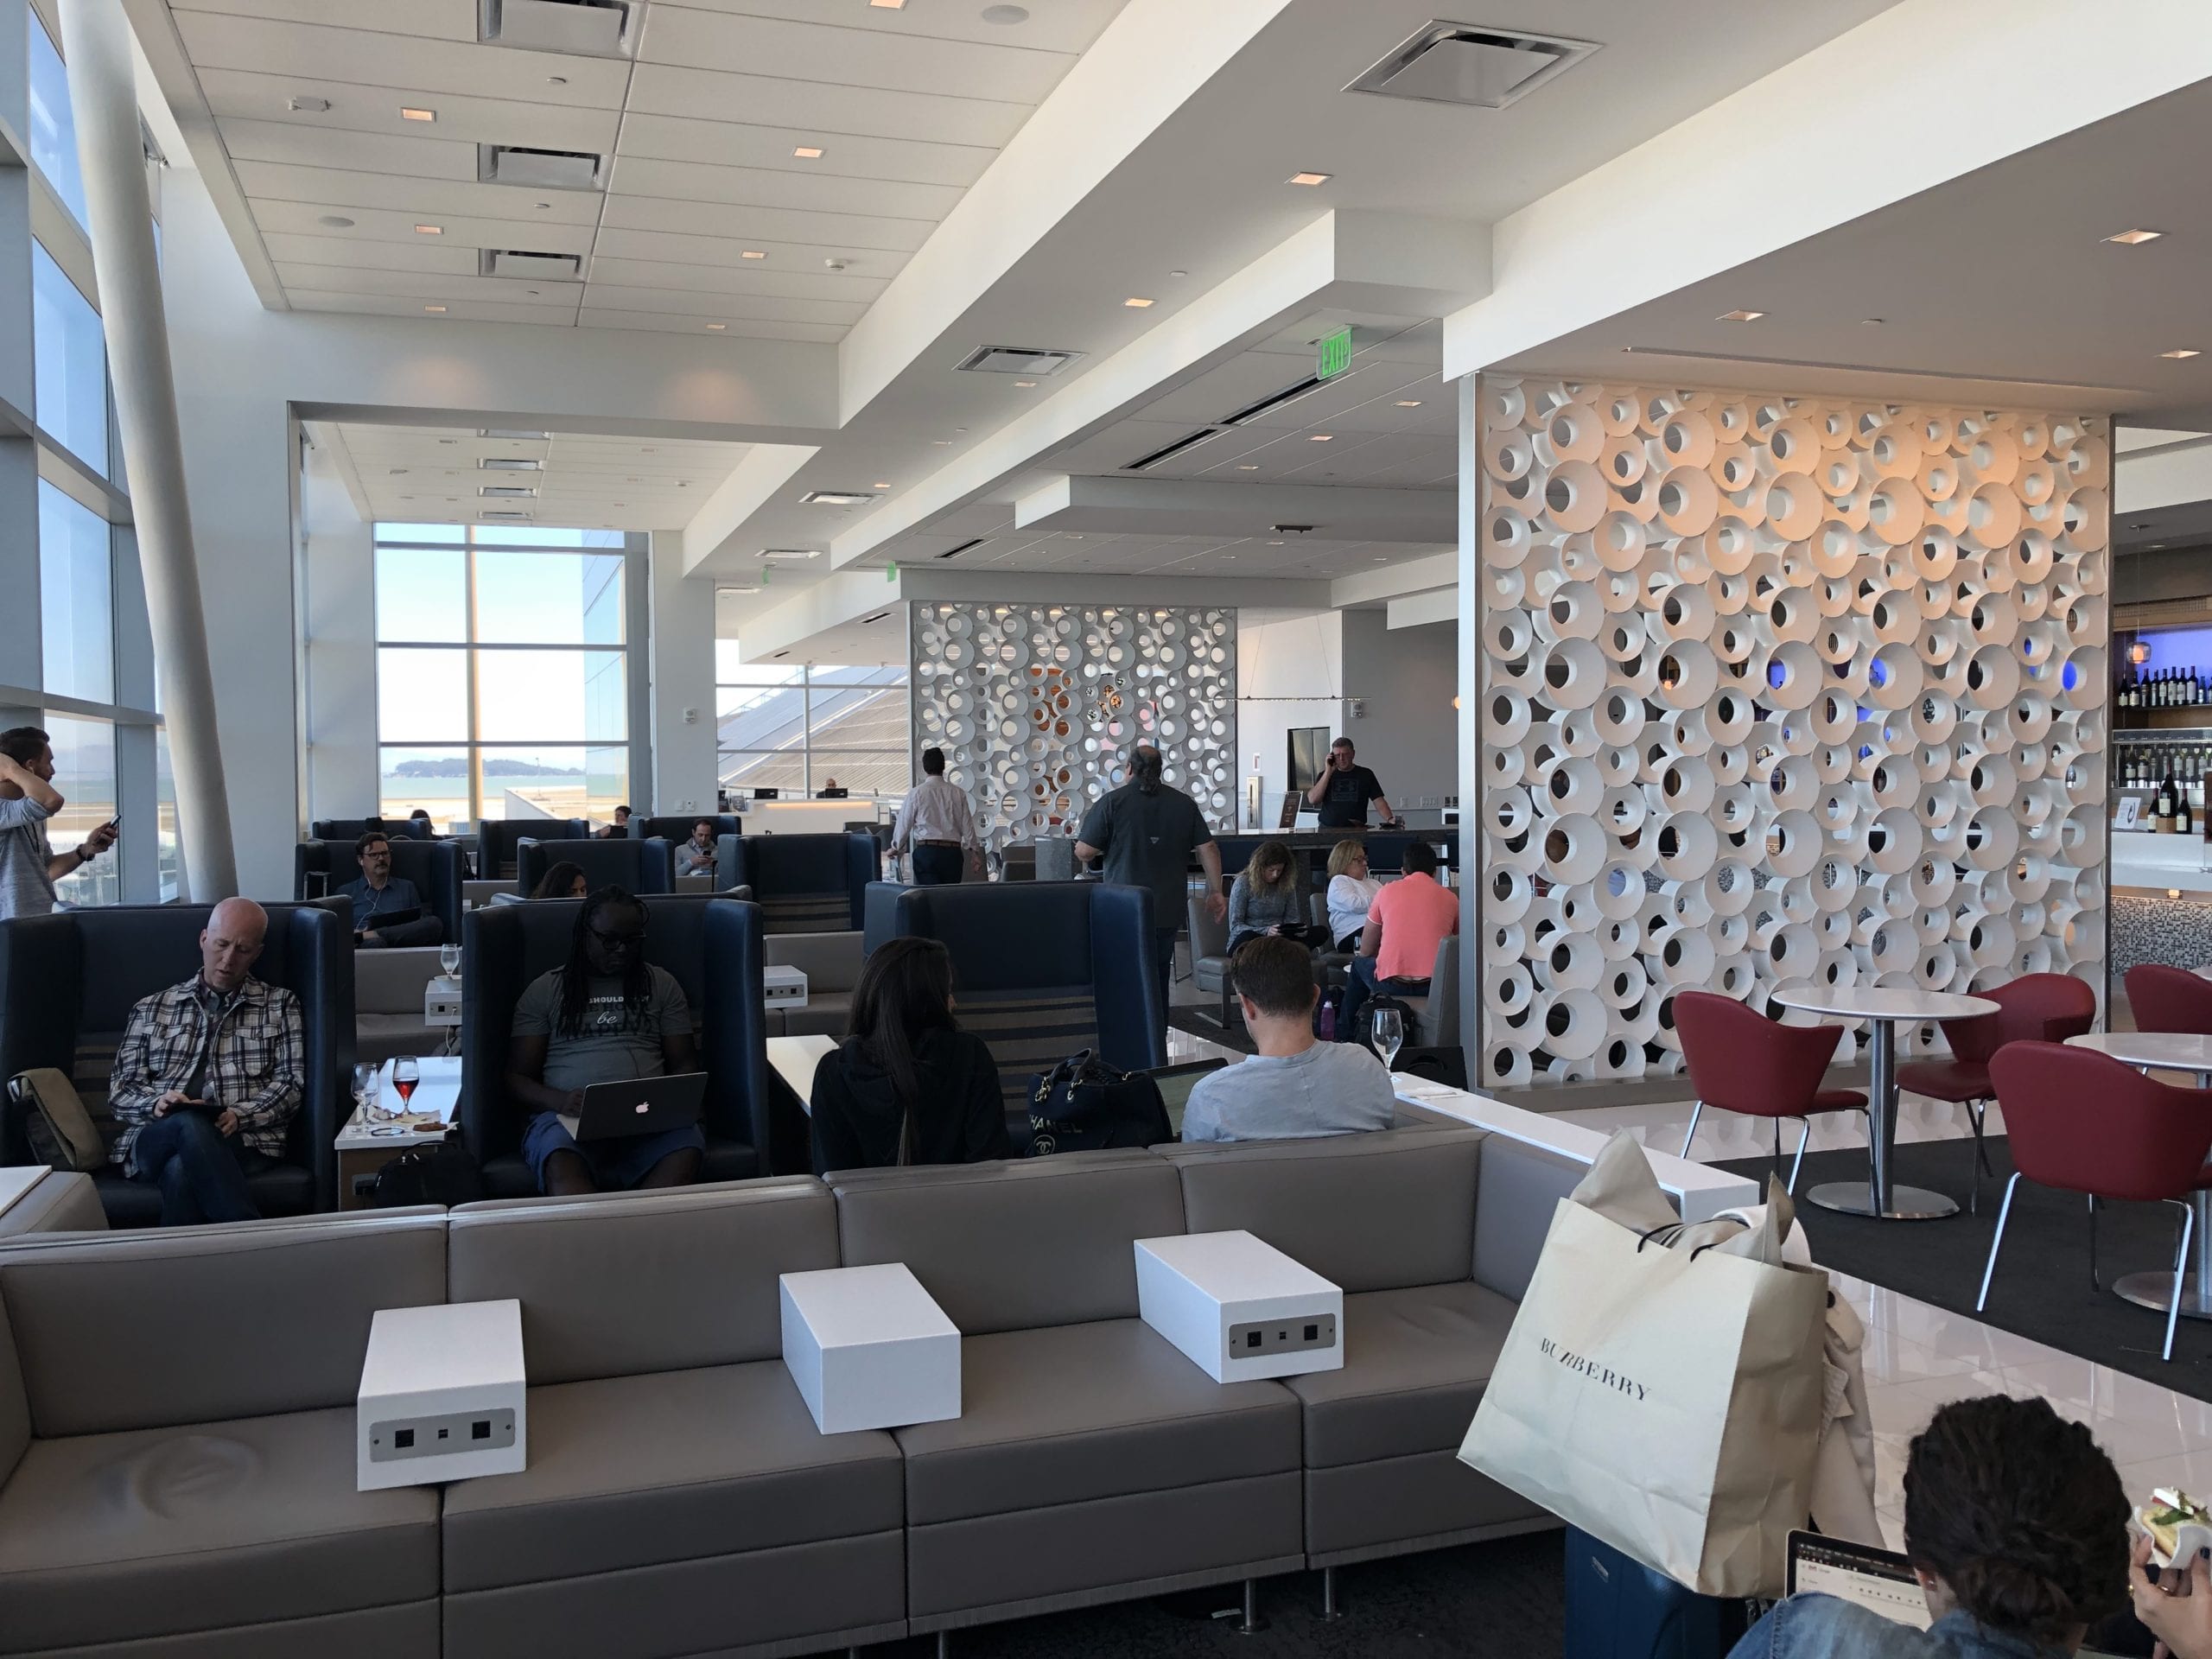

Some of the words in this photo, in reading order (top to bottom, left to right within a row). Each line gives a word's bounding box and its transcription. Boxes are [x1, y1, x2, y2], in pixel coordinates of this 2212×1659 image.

[1322, 333, 1344, 375] EXIT
[596, 1010, 618, 1024] be
[1029, 1114, 1084, 1134] HANEL
[1541, 1338, 1652, 1402] BURBERRY
